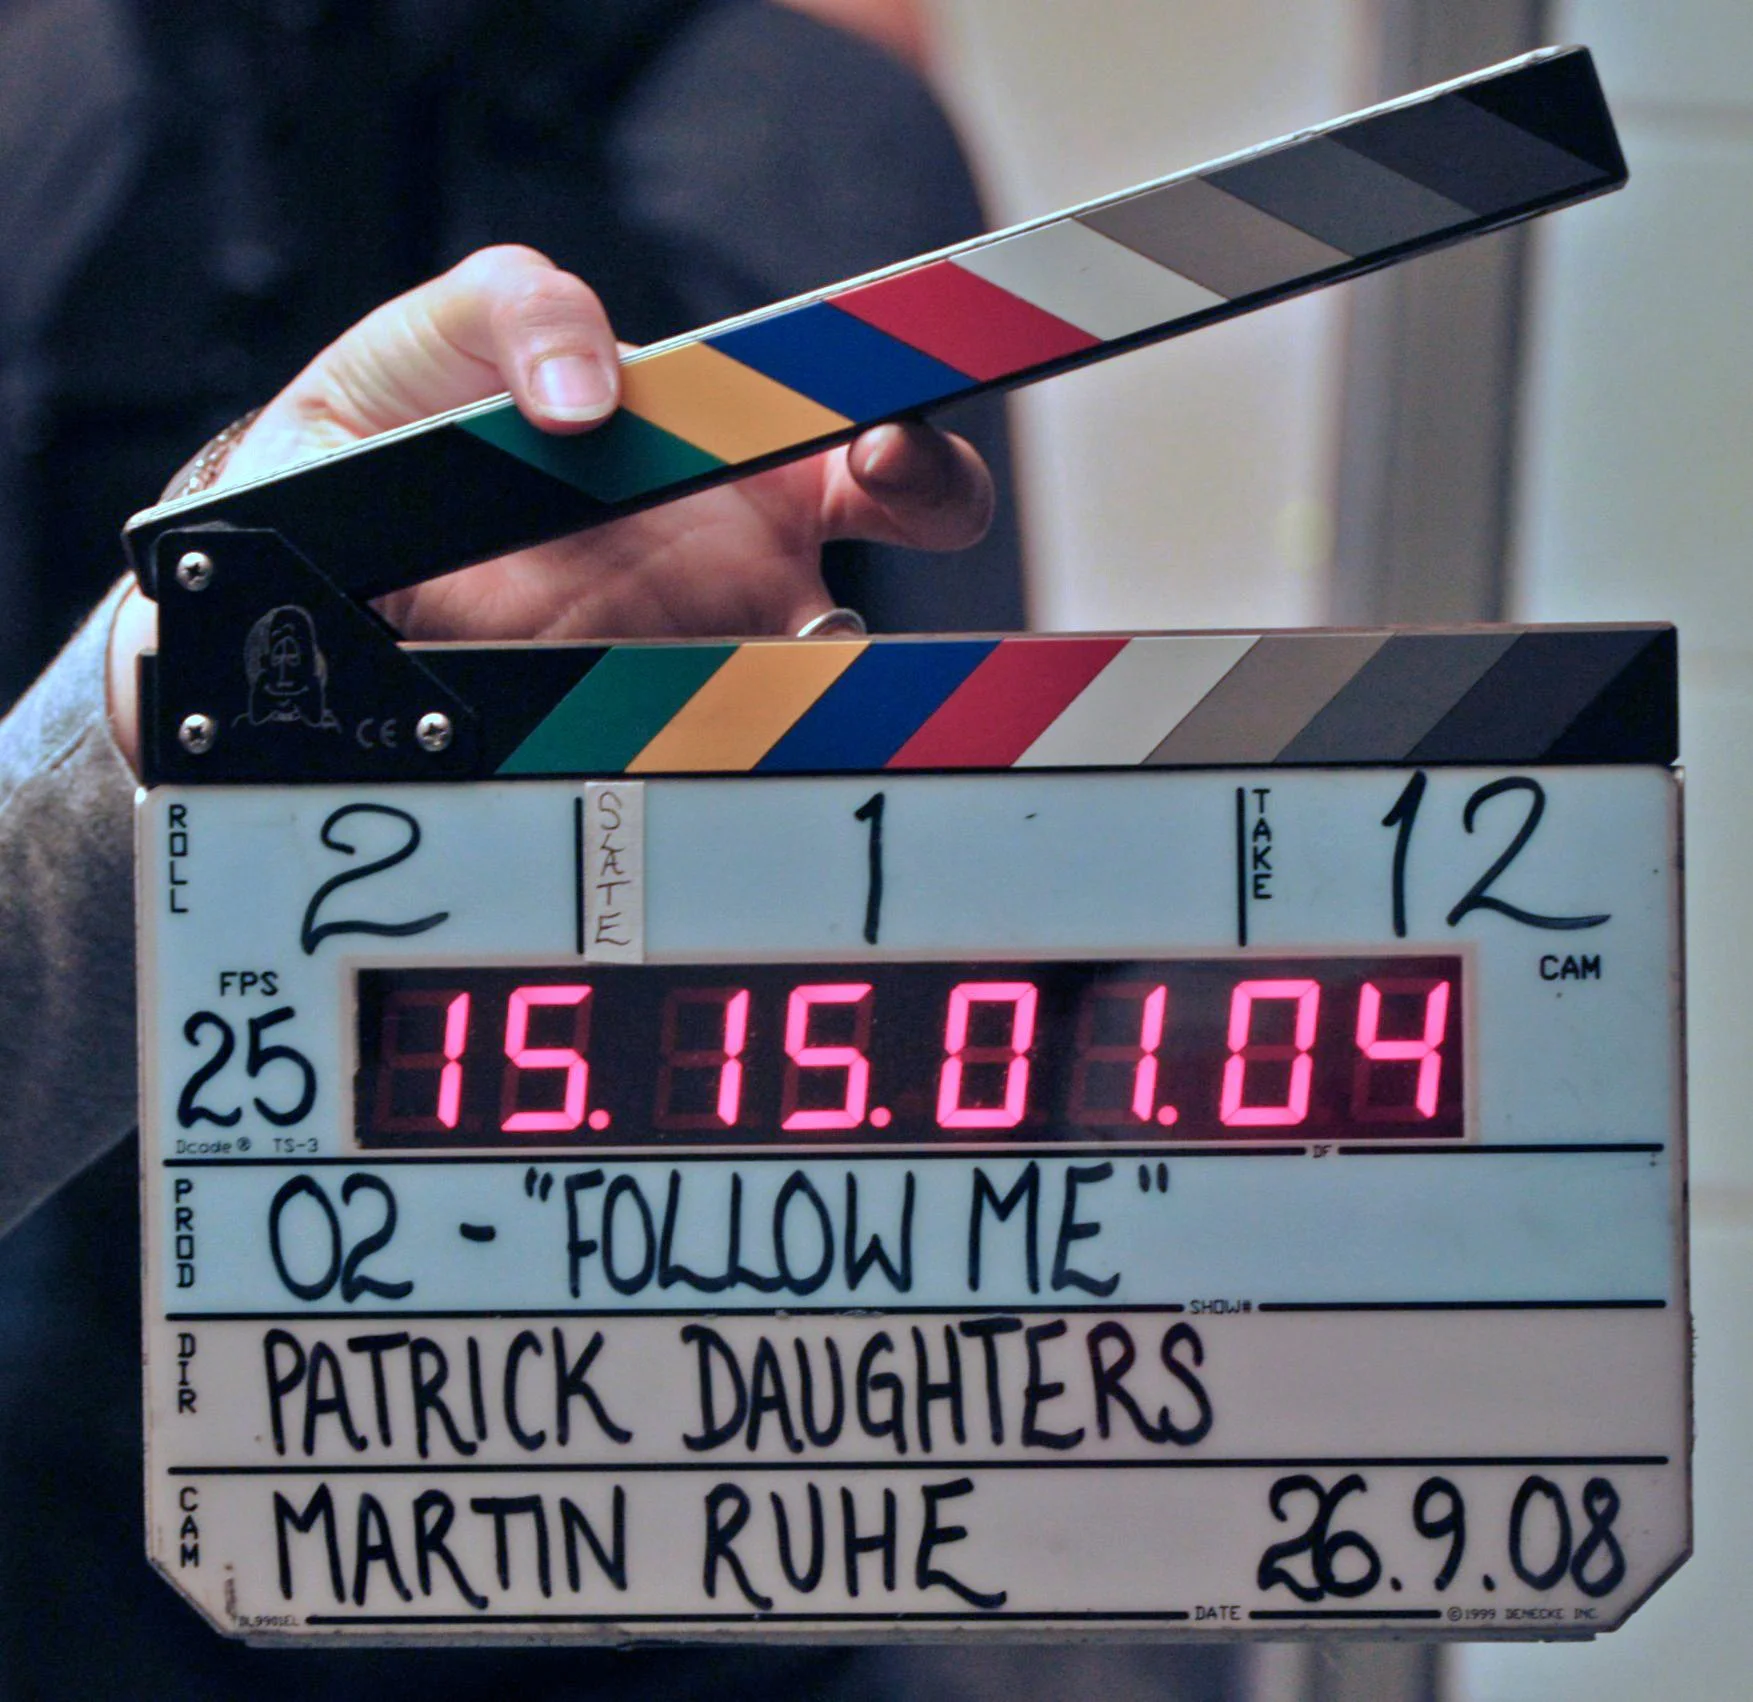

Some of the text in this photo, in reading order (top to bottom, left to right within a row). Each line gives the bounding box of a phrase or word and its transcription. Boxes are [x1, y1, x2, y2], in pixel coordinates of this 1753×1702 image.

[169, 804, 188, 913] ROLL
[301, 802, 449, 954] 2
[594, 791, 632, 946] SLATE
[854, 791, 886, 945] 1
[1252, 788, 1273, 900] TAKE
[1381, 770, 1612, 938] 12
[219, 971, 280, 996] FPS
[1539, 954, 1602, 981] CAM
[177, 1006, 318, 1128] 25
[272, 1138, 319, 1153] TS-3
[174, 1179, 196, 1289] PROD
[177, 1333, 198, 1414] DIR
[263, 1317, 1214, 1460] PATRICK DAUGHTERS
[178, 1487, 200, 1570] CAM
[272, 1477, 1008, 1611] MARTIN RUHE
[1257, 1473, 1626, 1602] 26.9.08
[1195, 1606, 1242, 1621] DATE
[1504, 1607, 1565, 1620] DENECKE
